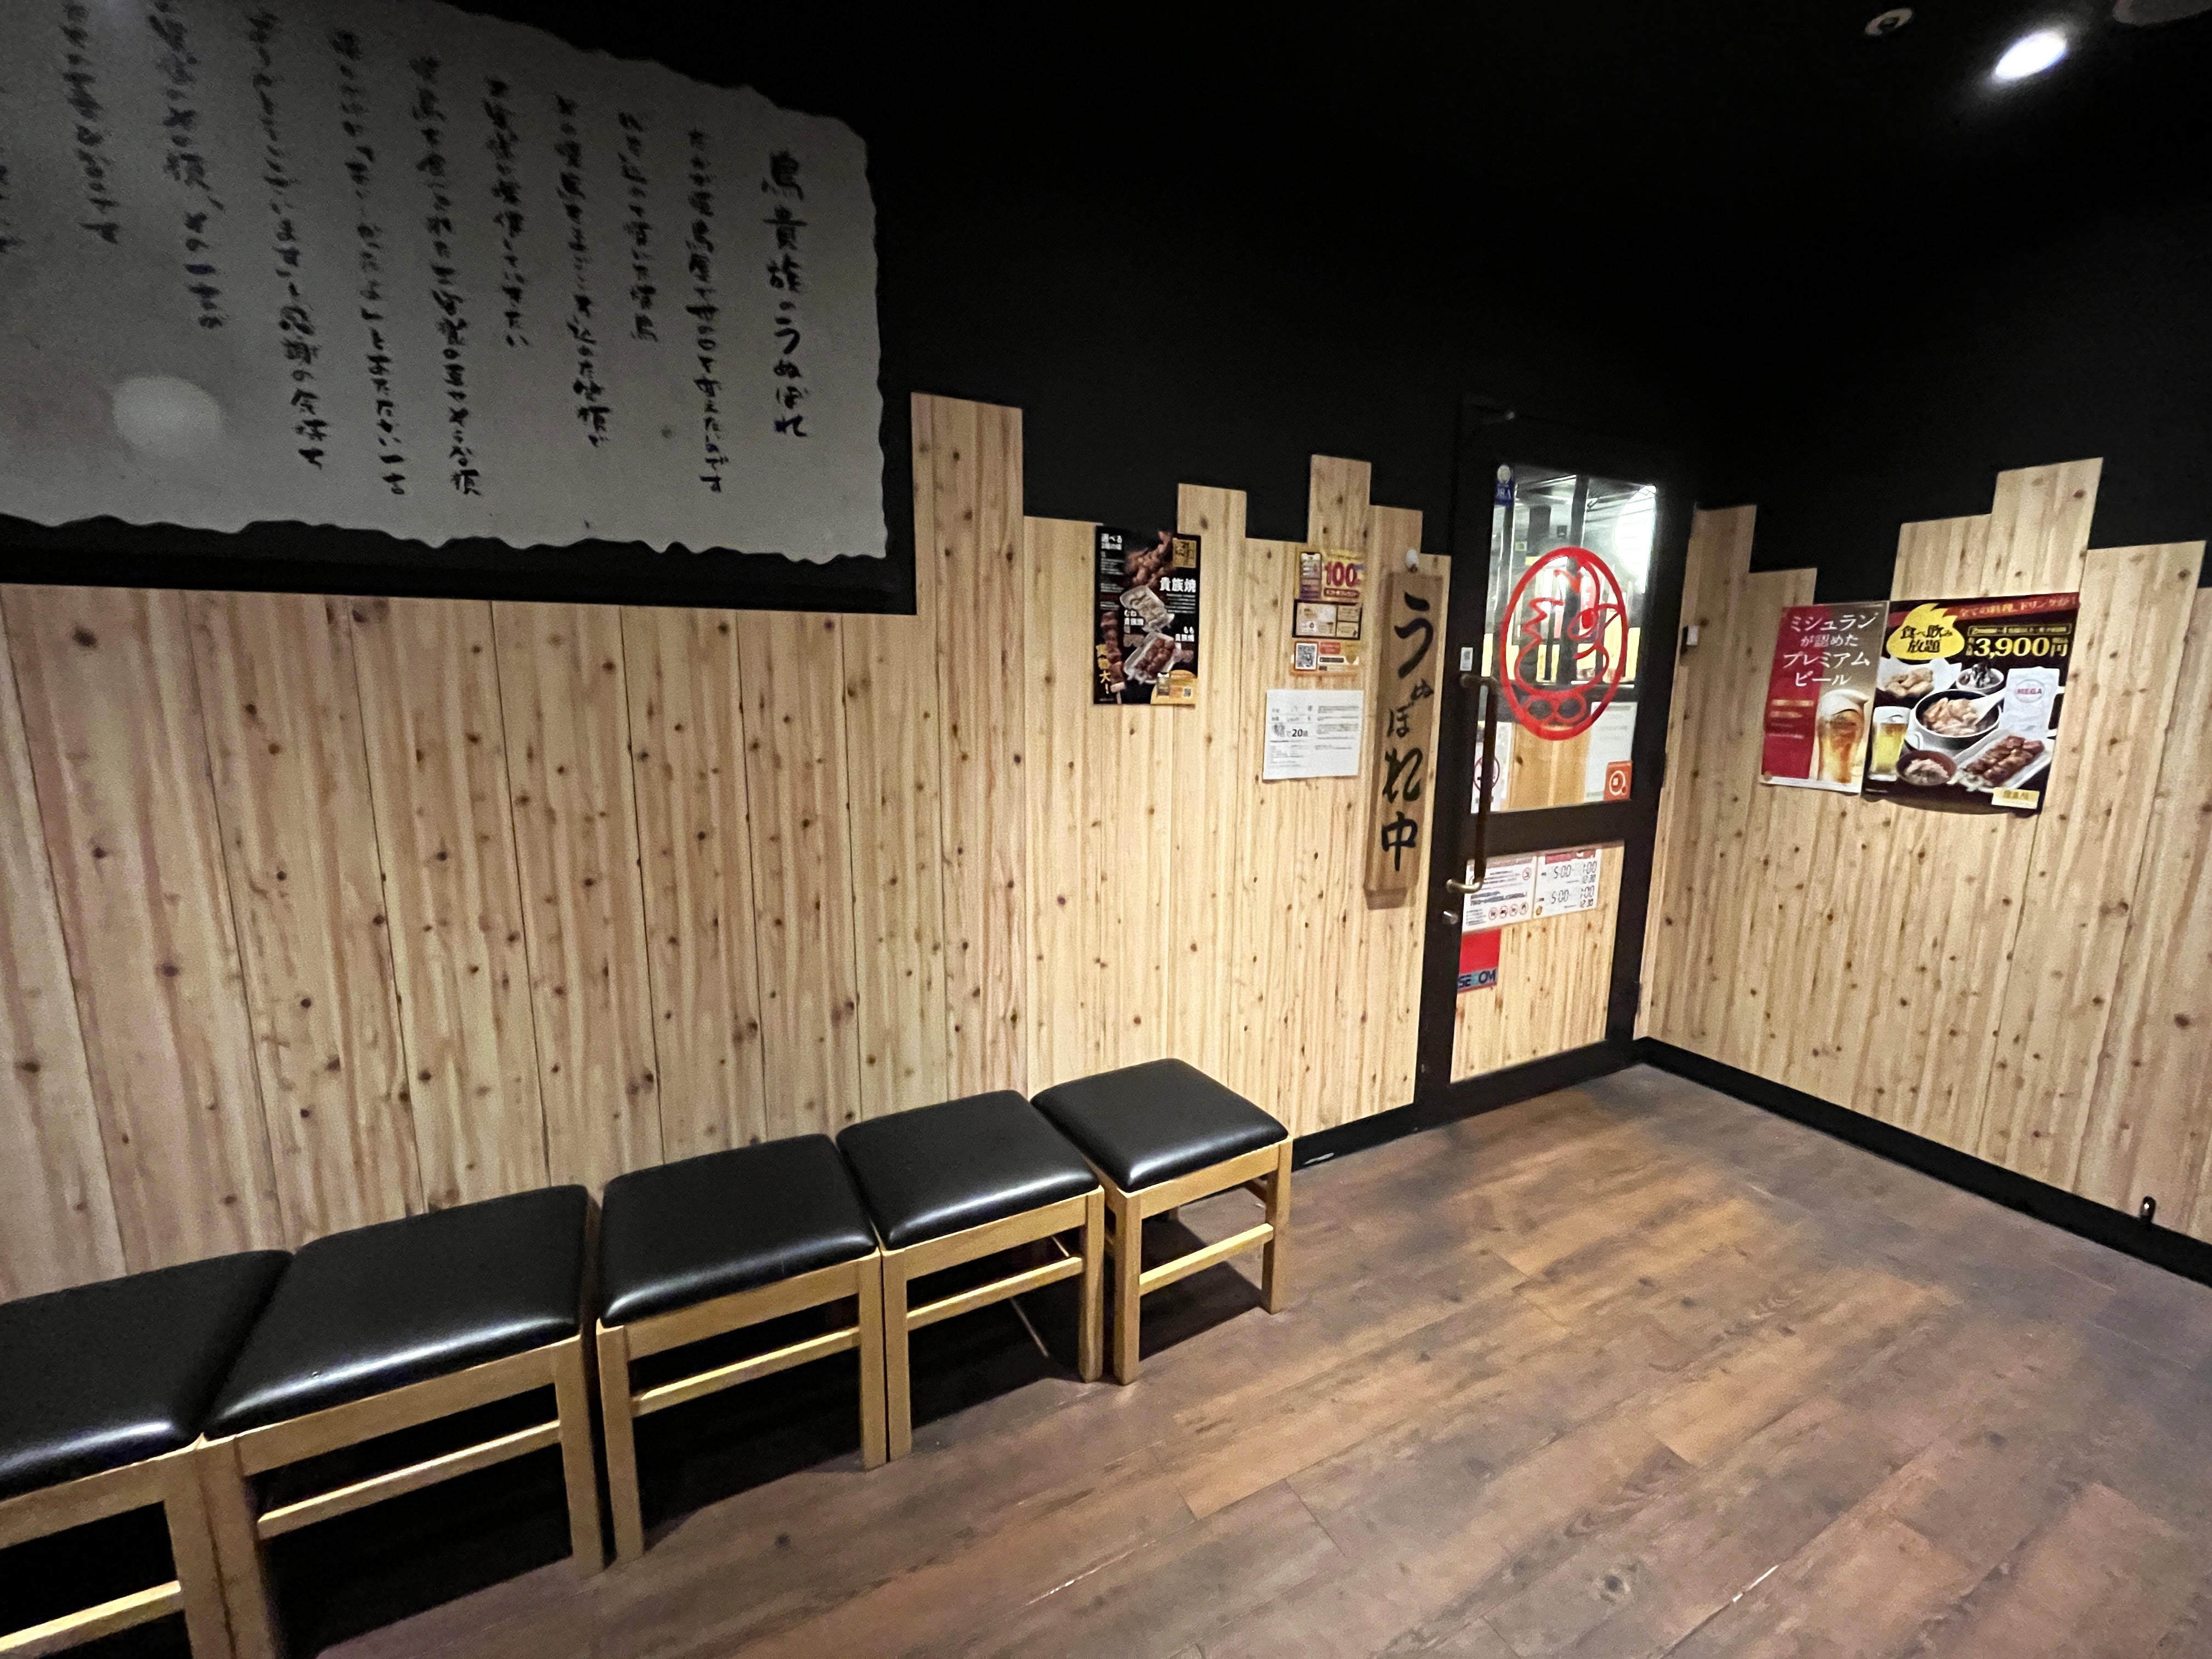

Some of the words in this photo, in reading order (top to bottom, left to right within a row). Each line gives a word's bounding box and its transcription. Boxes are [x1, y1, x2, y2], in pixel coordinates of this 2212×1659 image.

[761, 150, 808, 437] 鳥貴族のうぬぼれ
[1159, 577, 1196, 592] 貴族焼
[1791, 612, 1879, 632] ミシュラン
[1800, 633, 1859, 648] が認めた
[1782, 651, 1871, 669] プレミアム
[1795, 670, 1852, 687] ビール
[1381, 591, 1434, 871] うぬぼれ中
[1458, 968, 1497, 988] SEOM
